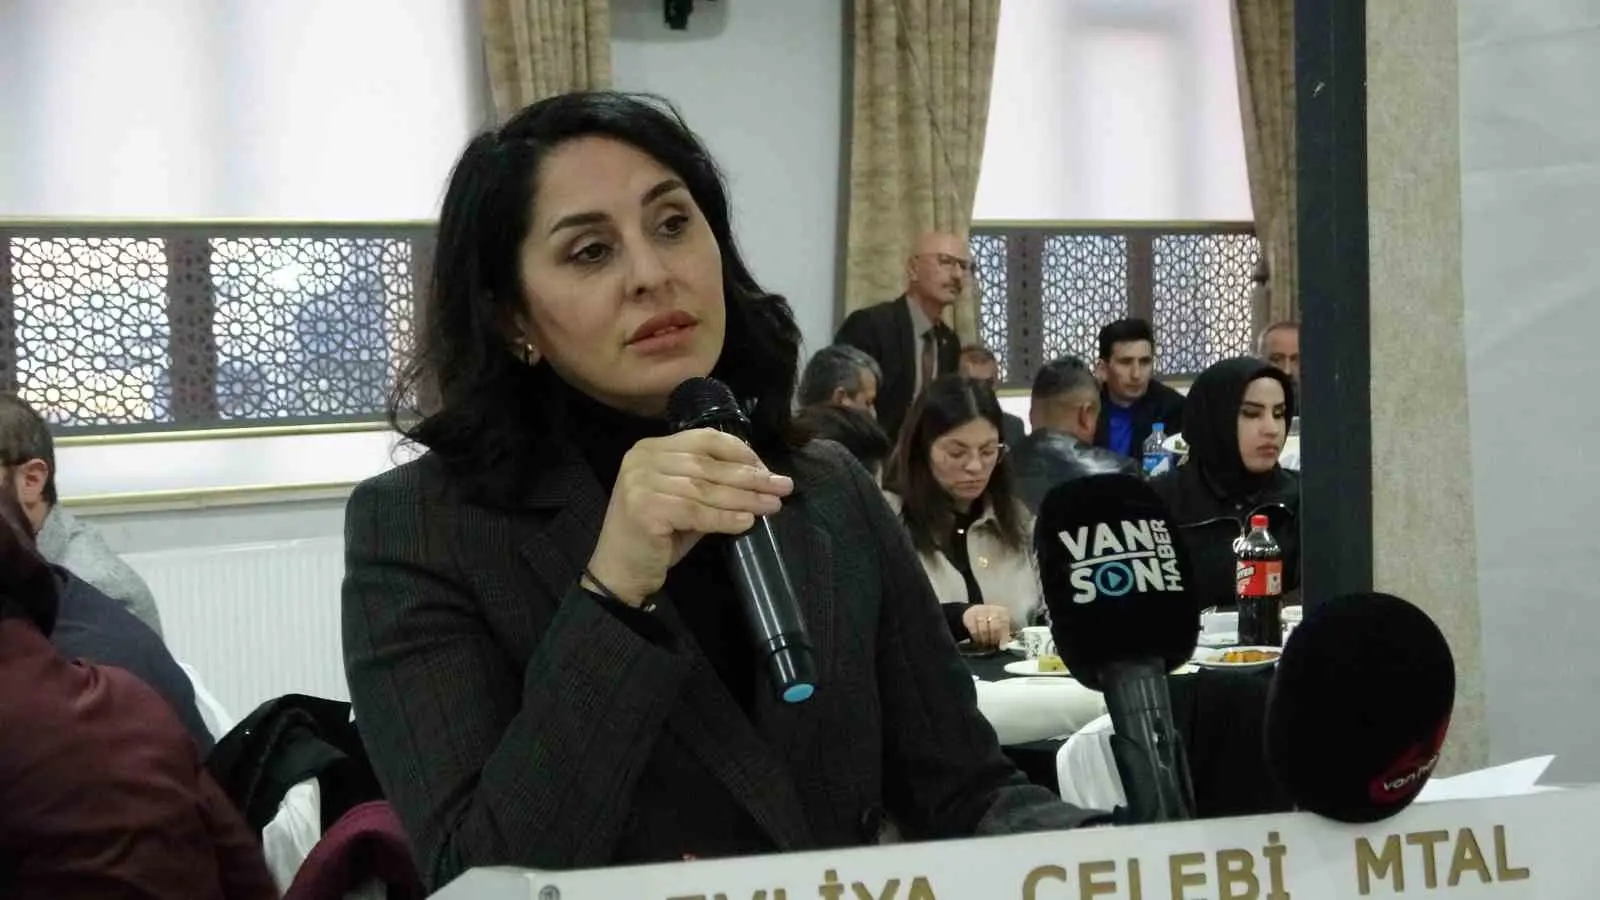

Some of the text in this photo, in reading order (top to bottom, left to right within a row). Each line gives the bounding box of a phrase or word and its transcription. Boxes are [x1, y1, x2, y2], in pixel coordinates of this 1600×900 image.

[1058, 519, 1156, 561] VAN
[1150, 519, 1184, 592] HABER
[1070, 558, 1165, 604] SON
[1355, 824, 1530, 895] MTAL
